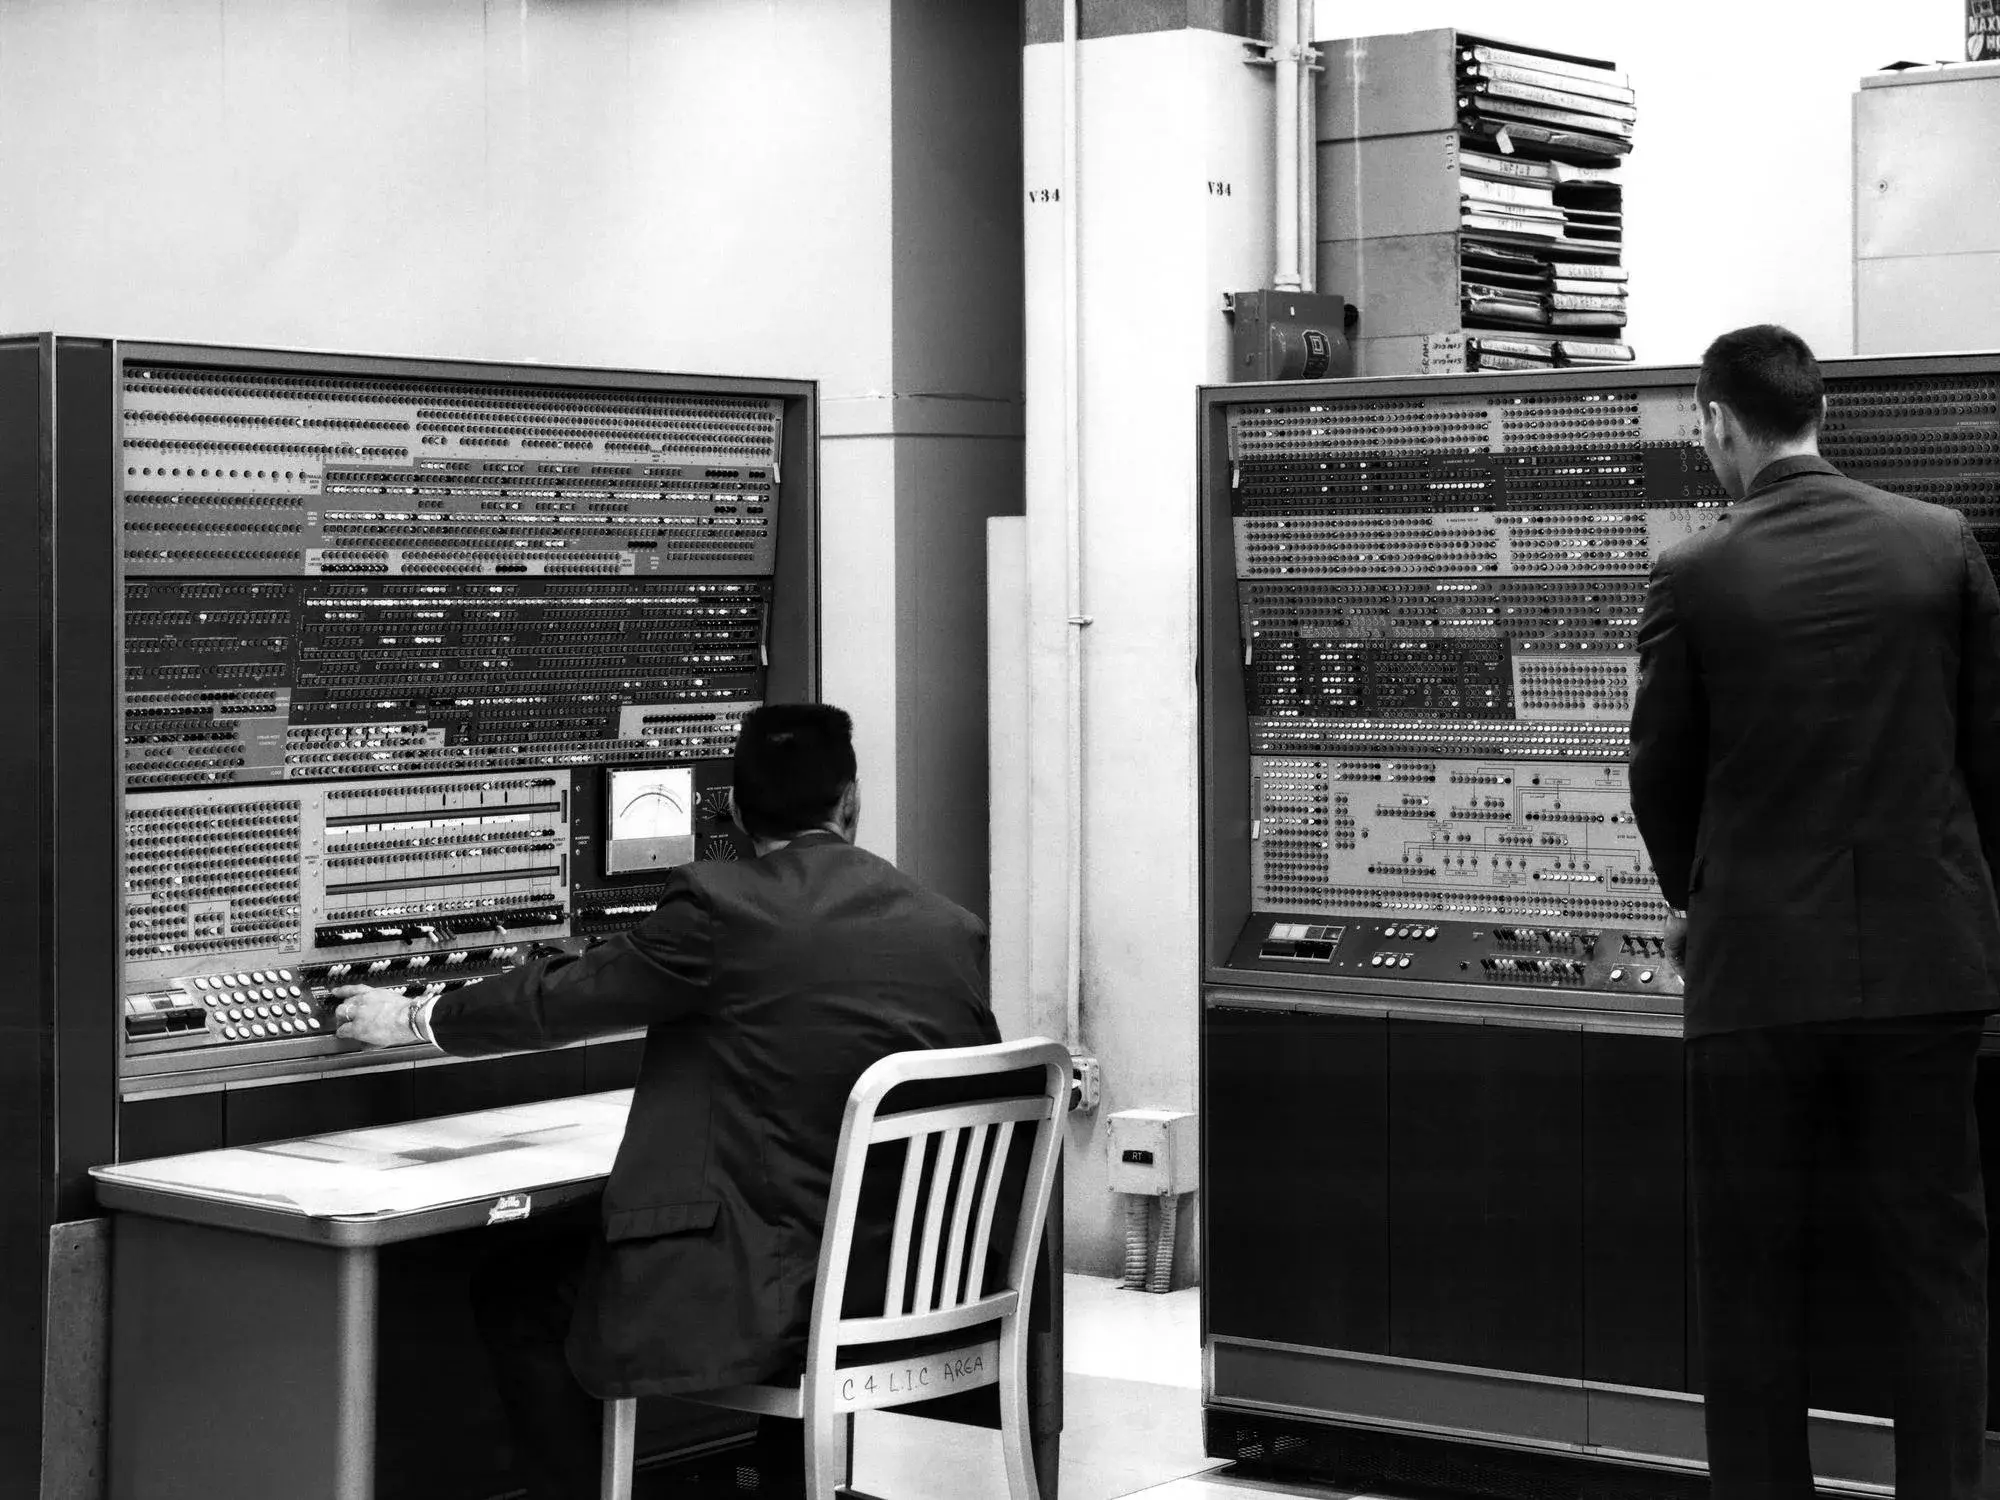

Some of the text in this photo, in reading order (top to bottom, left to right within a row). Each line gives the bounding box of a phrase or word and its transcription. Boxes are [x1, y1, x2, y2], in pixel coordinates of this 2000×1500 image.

[1029, 188, 1060, 204] V34
[1208, 181, 1232, 197] V34
[1132, 1152, 1142, 1160] RT
[943, 1356, 984, 1382] AREA
